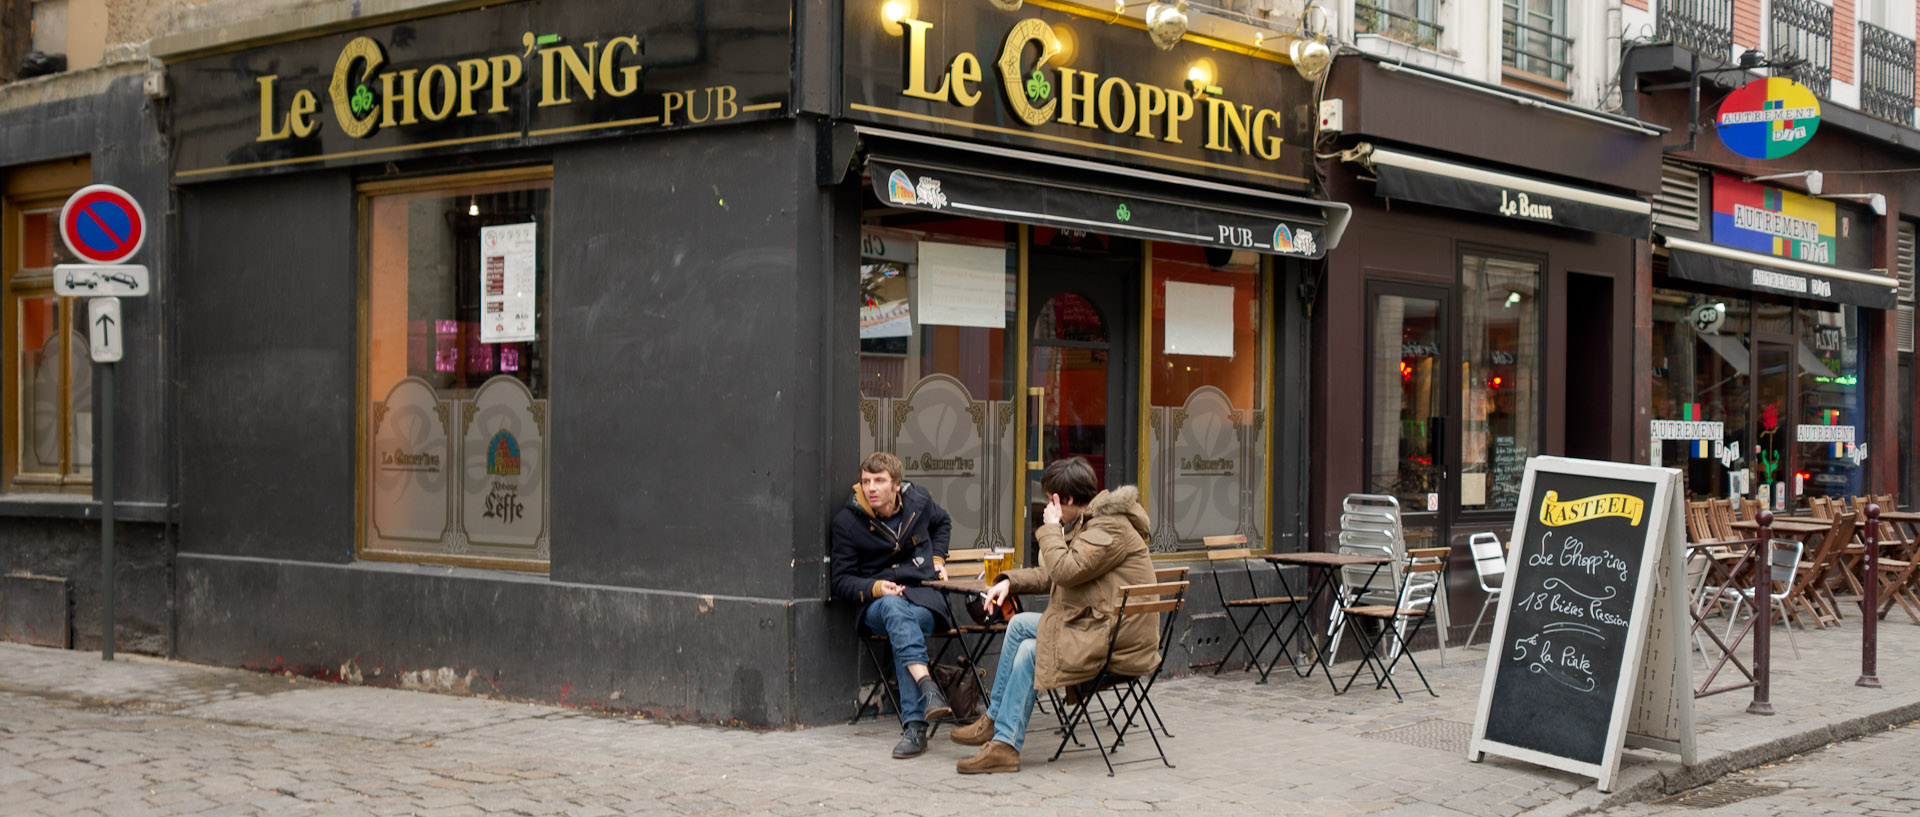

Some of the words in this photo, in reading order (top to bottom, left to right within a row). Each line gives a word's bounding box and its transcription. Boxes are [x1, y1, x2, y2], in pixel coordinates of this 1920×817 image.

[902, 18, 982, 107] Le
[256, 74, 316, 142] Le
[661, 86, 739, 127] PUB
[1722, 107, 1815, 124] AUTREMENT
[1773, 127, 1805, 141] DIT
[1500, 190, 1517, 217] Le
[1519, 192, 1553, 219] Bam
[1218, 225, 1253, 247] PUB
[1734, 203, 1818, 243] AUTREMENT
[1800, 241, 1828, 263] DIT
[1753, 269, 1807, 293] AUTREMENT
[1811, 279, 1832, 297] DIT
[1651, 421, 1723, 439] AUTREMENT
[1798, 425, 1855, 441] AUTREMENT
[1715, 441, 1739, 467] DIT
[482, 491, 524, 524] Leffe
[1543, 497, 1634, 521] KASTEEL
[1529, 531, 1554, 567] Le
[1559, 536, 1628, 582] Chopp'ing
[1518, 592, 1548, 611] 18
[1590, 600, 1629, 627] Pression
[1540, 640, 1554, 664] la
[1561, 645, 1593, 675] Pinte
